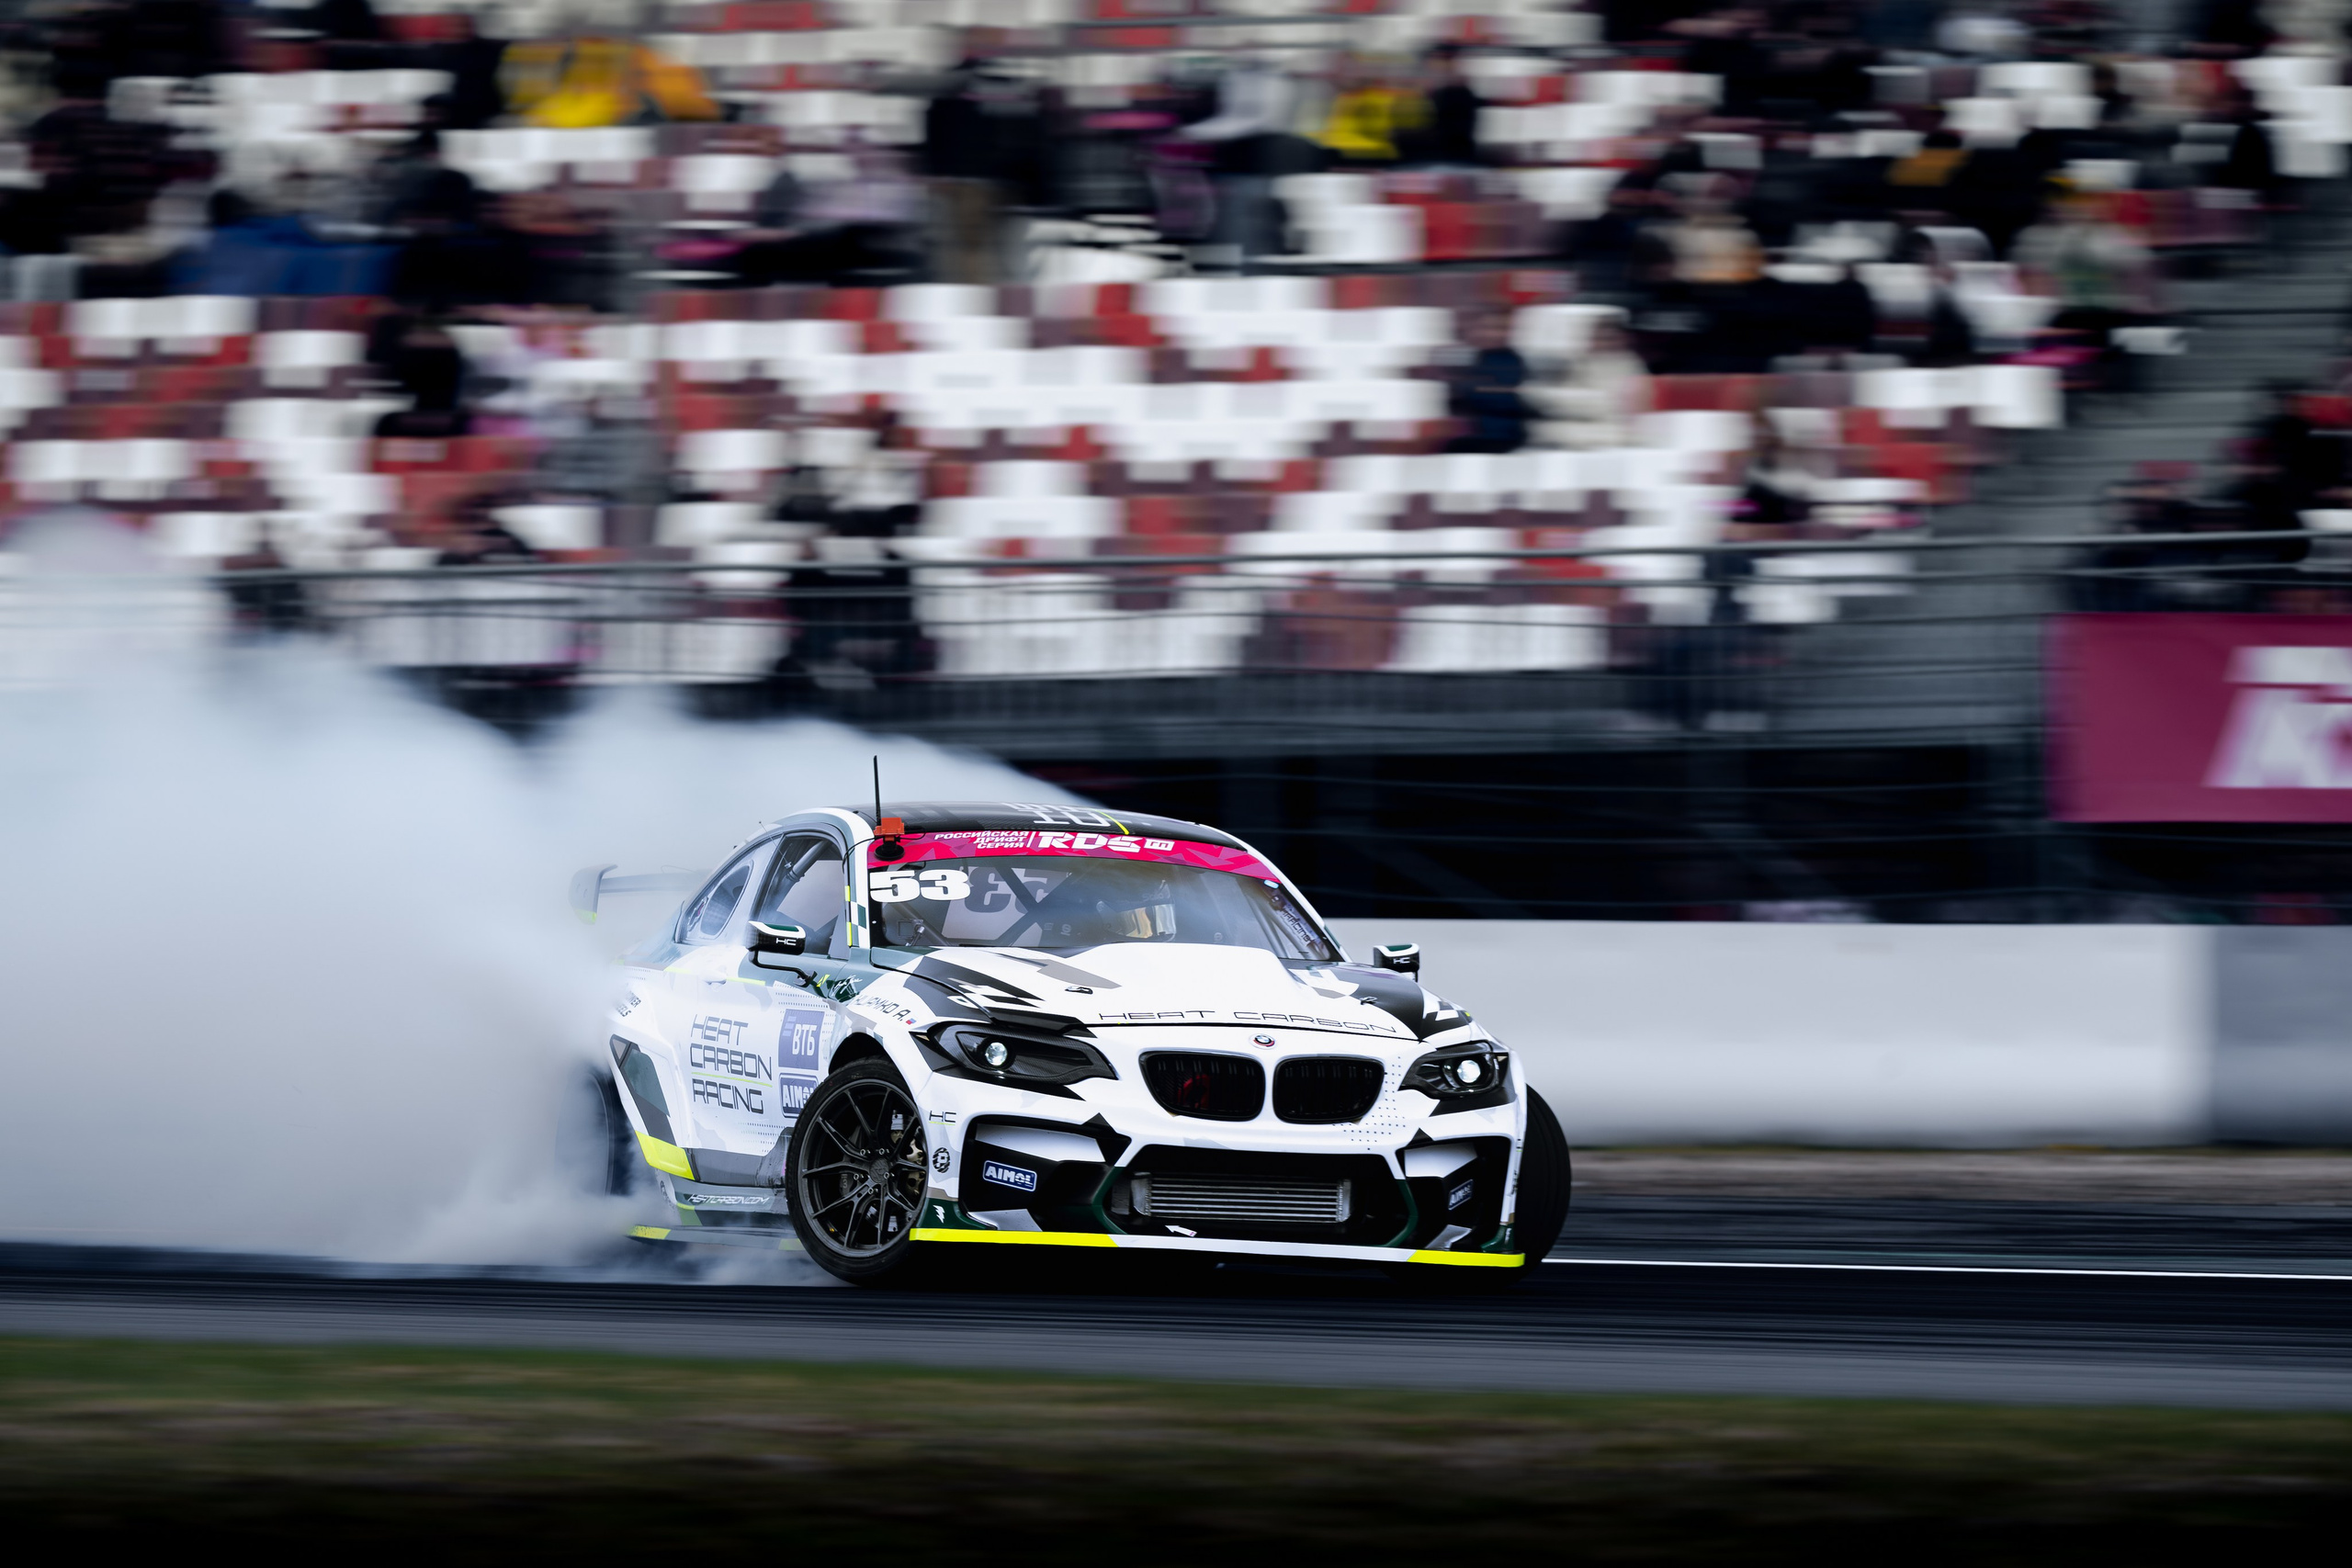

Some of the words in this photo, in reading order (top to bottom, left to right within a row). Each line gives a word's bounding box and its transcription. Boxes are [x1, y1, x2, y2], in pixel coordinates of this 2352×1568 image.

[934, 830, 1029, 840] РОССИЙСКАЯ
[973, 836, 1027, 844] ДРИФТ
[1038, 831, 1143, 852] RDS
[870, 869, 970, 903] 53
[776, 938, 797, 946] HC
[1393, 956, 1410, 964] HC
[690, 1014, 749, 1045] HEAT
[1099, 1010, 1216, 1020] HEAT
[1234, 1011, 1396, 1032] CARBON
[792, 1023, 817, 1056] ВТБ
[690, 1043, 773, 1080] CARBON
[692, 1078, 763, 1114] RACING
[929, 1111, 956, 1123] HC
[985, 1166, 1034, 1187] AIMOL
